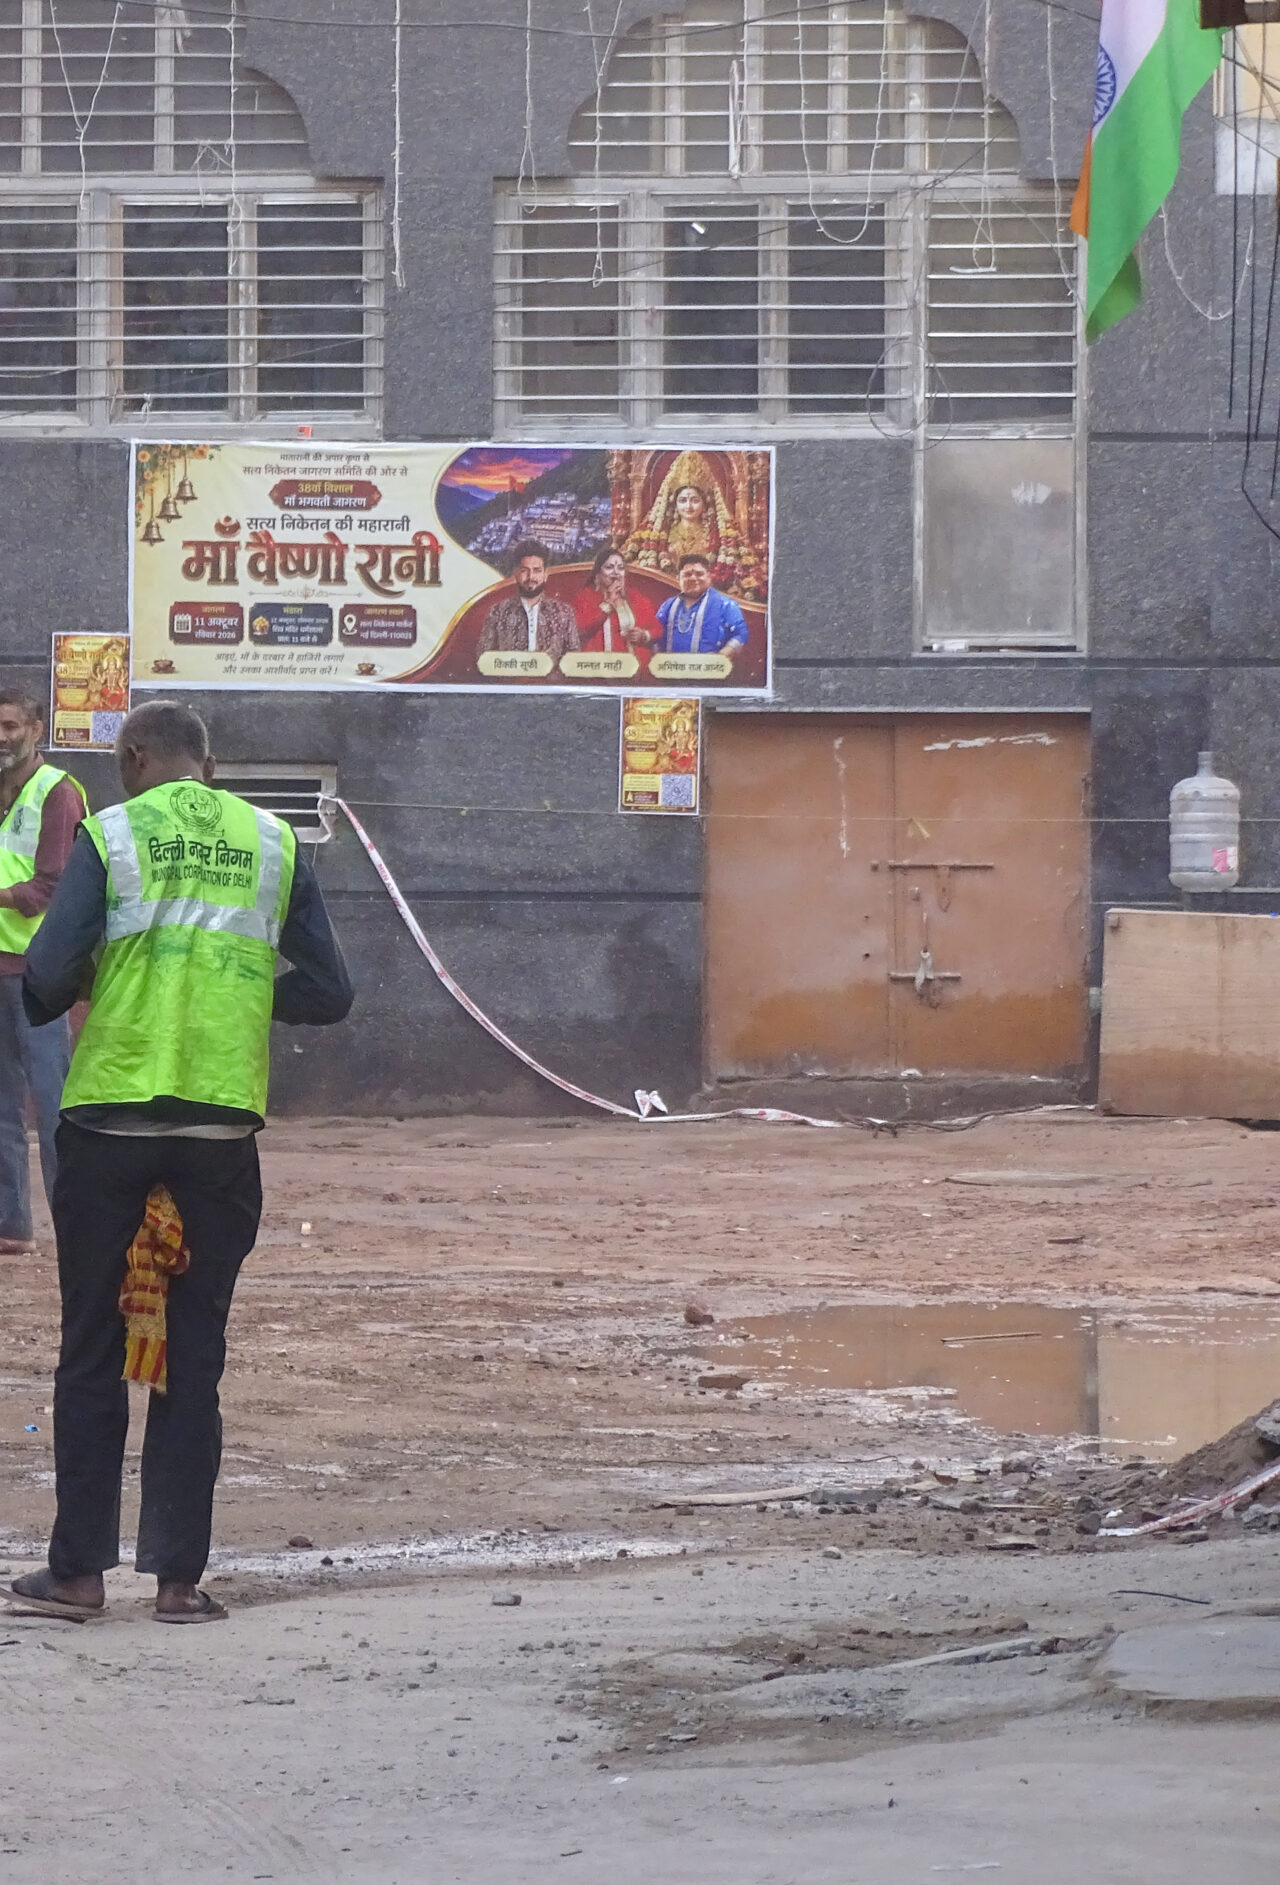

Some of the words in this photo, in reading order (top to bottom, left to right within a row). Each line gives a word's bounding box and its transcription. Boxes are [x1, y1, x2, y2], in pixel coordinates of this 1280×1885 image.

[243, 466, 261, 475] सत्य
[265, 465, 296, 475] निकेतन
[298, 466, 331, 476] जागरण
[333, 464, 362, 476] समिति
[365, 464, 377, 476] की
[380, 465, 397, 476] ओर
[399, 465, 408, 476] से
[324, 481, 354, 493] विशाल
[298, 495, 331, 507] भगवती
[333, 497, 367, 508] जागरण
[247, 517, 276, 531] सत्य
[280, 515, 330, 531] निकेतन
[335, 515, 353, 531] की
[358, 515, 410, 532] महारानी
[182, 515, 241, 586] माँ
[245, 531, 349, 586] वैष्णो
[354, 531, 444, 599] रानी
[195, 617, 206, 626] 11
[149, 834, 184, 863] दिल्ली
[215, 839, 254, 870] निगम
[222, 874, 231, 886] OF
[233, 873, 253, 889] DELHI
